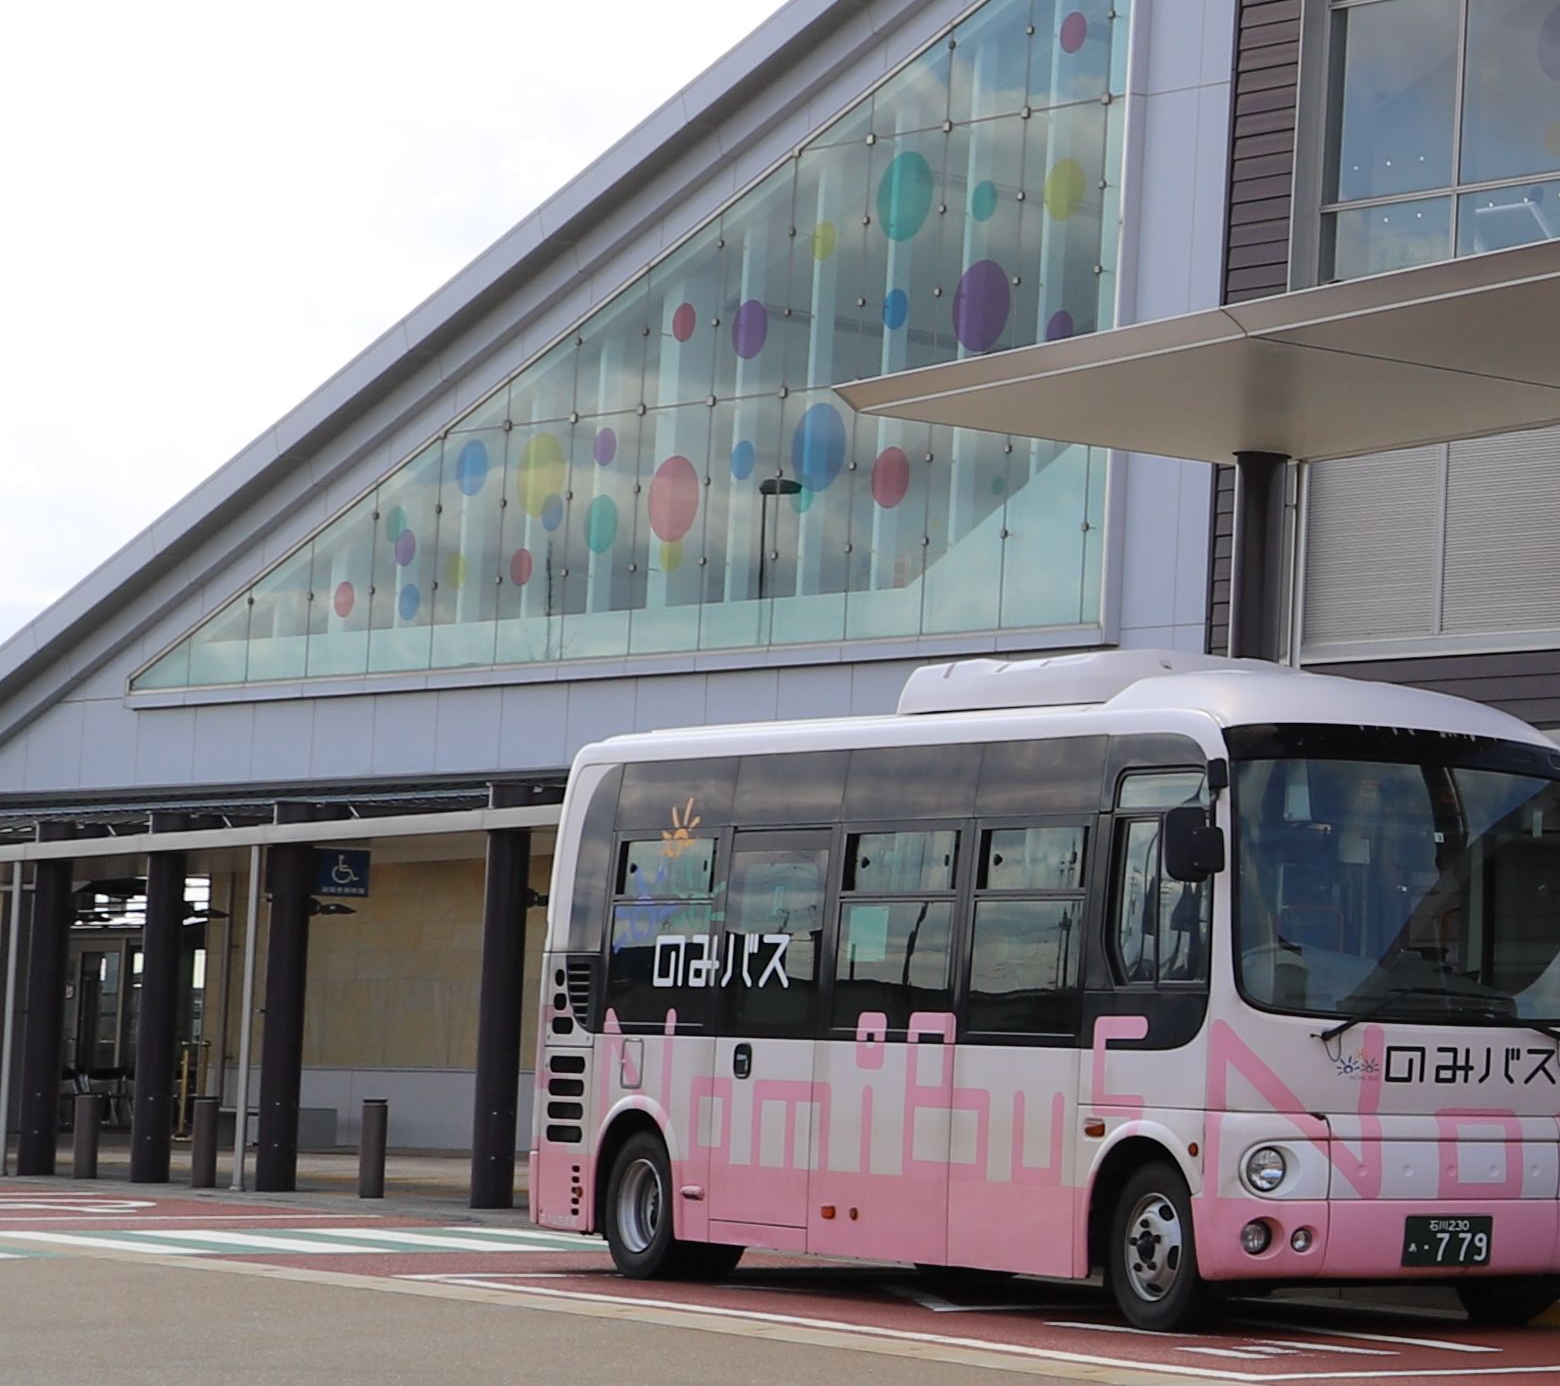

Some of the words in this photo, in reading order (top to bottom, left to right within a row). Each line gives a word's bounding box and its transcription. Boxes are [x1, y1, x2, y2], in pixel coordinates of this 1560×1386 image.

[653, 933, 791, 989] のみバス
[1384, 1046, 1557, 1085] のみバス
[1429, 1220, 1470, 1231] 石川230
